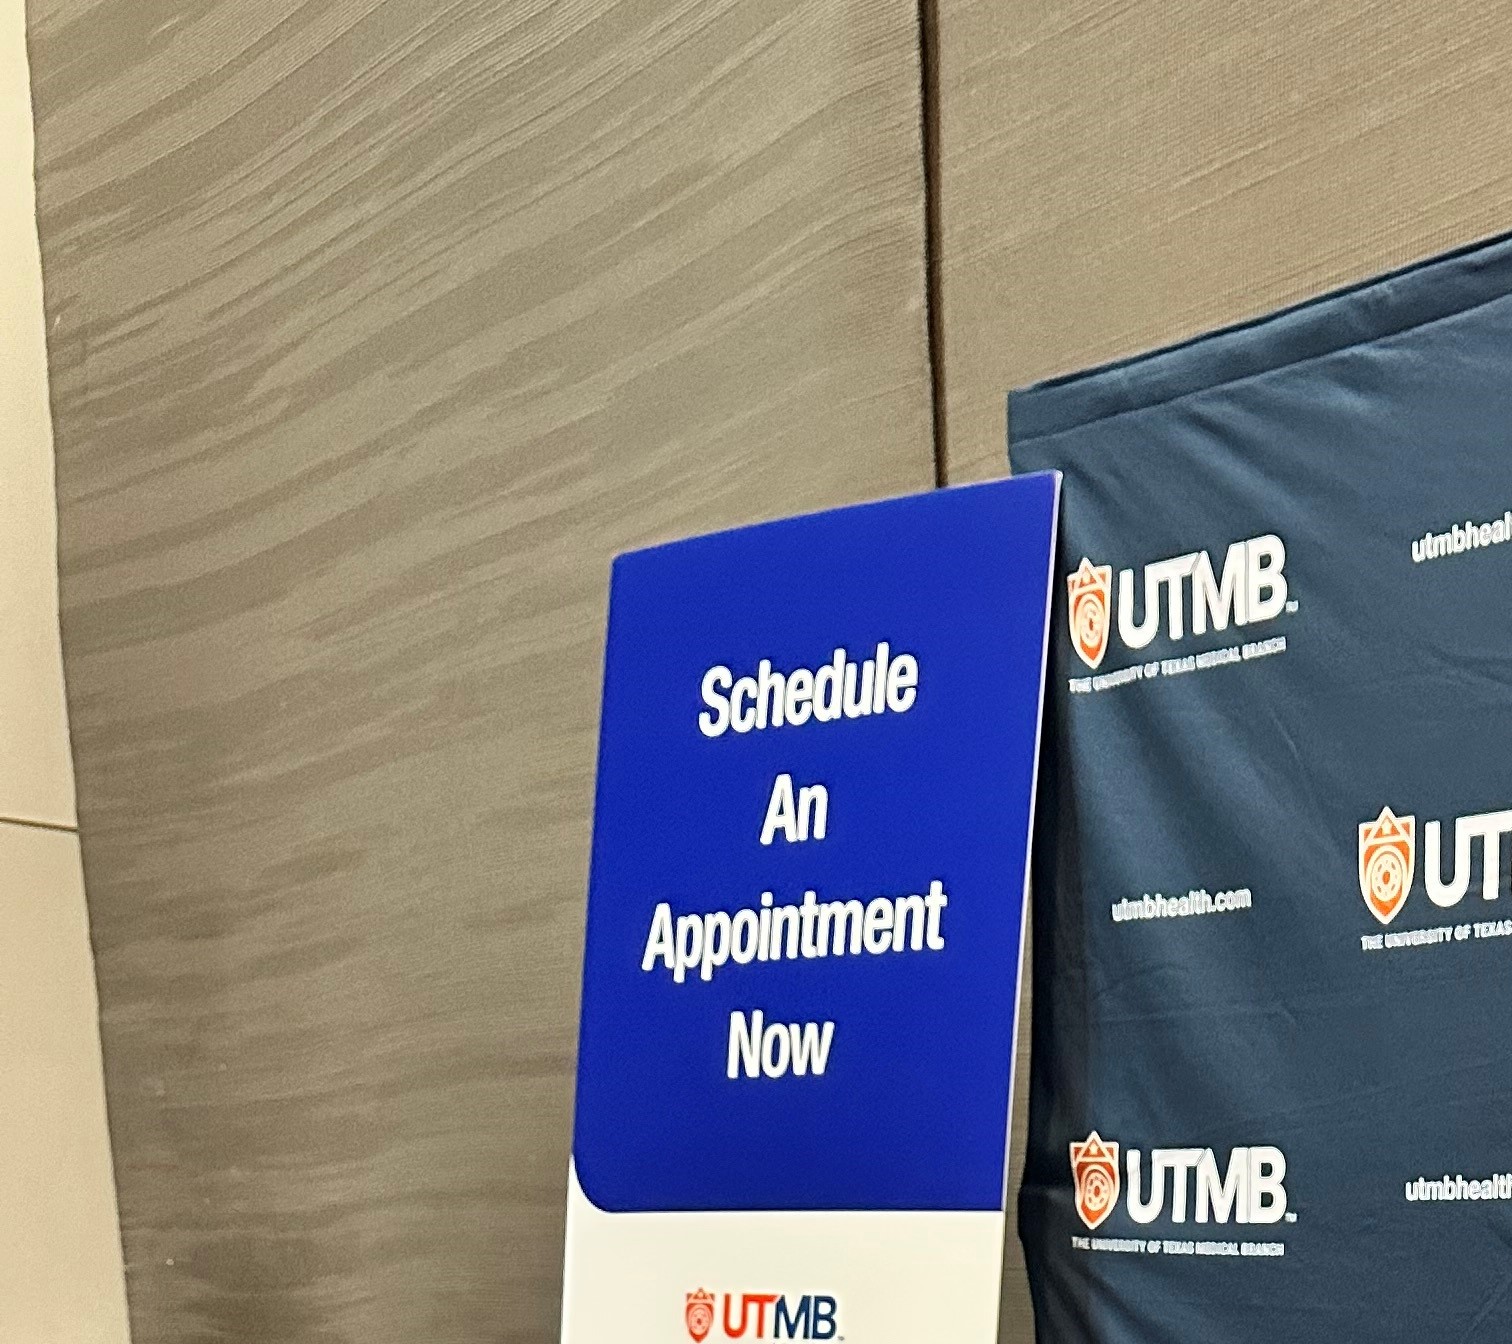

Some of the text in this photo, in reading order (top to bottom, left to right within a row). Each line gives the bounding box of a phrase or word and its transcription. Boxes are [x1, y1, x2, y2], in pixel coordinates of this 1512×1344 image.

[1117, 533, 1289, 650] UTMB
[698, 641, 919, 739] Schedule
[759, 773, 827, 847] An
[641, 880, 949, 985] Appointment
[1453, 923, 1472, 941] OF
[1472, 919, 1512, 939] TEXAS
[726, 1009, 835, 1080] Now
[1125, 1145, 1288, 1224] UTMB
[723, 1292, 838, 1341] UTMB
